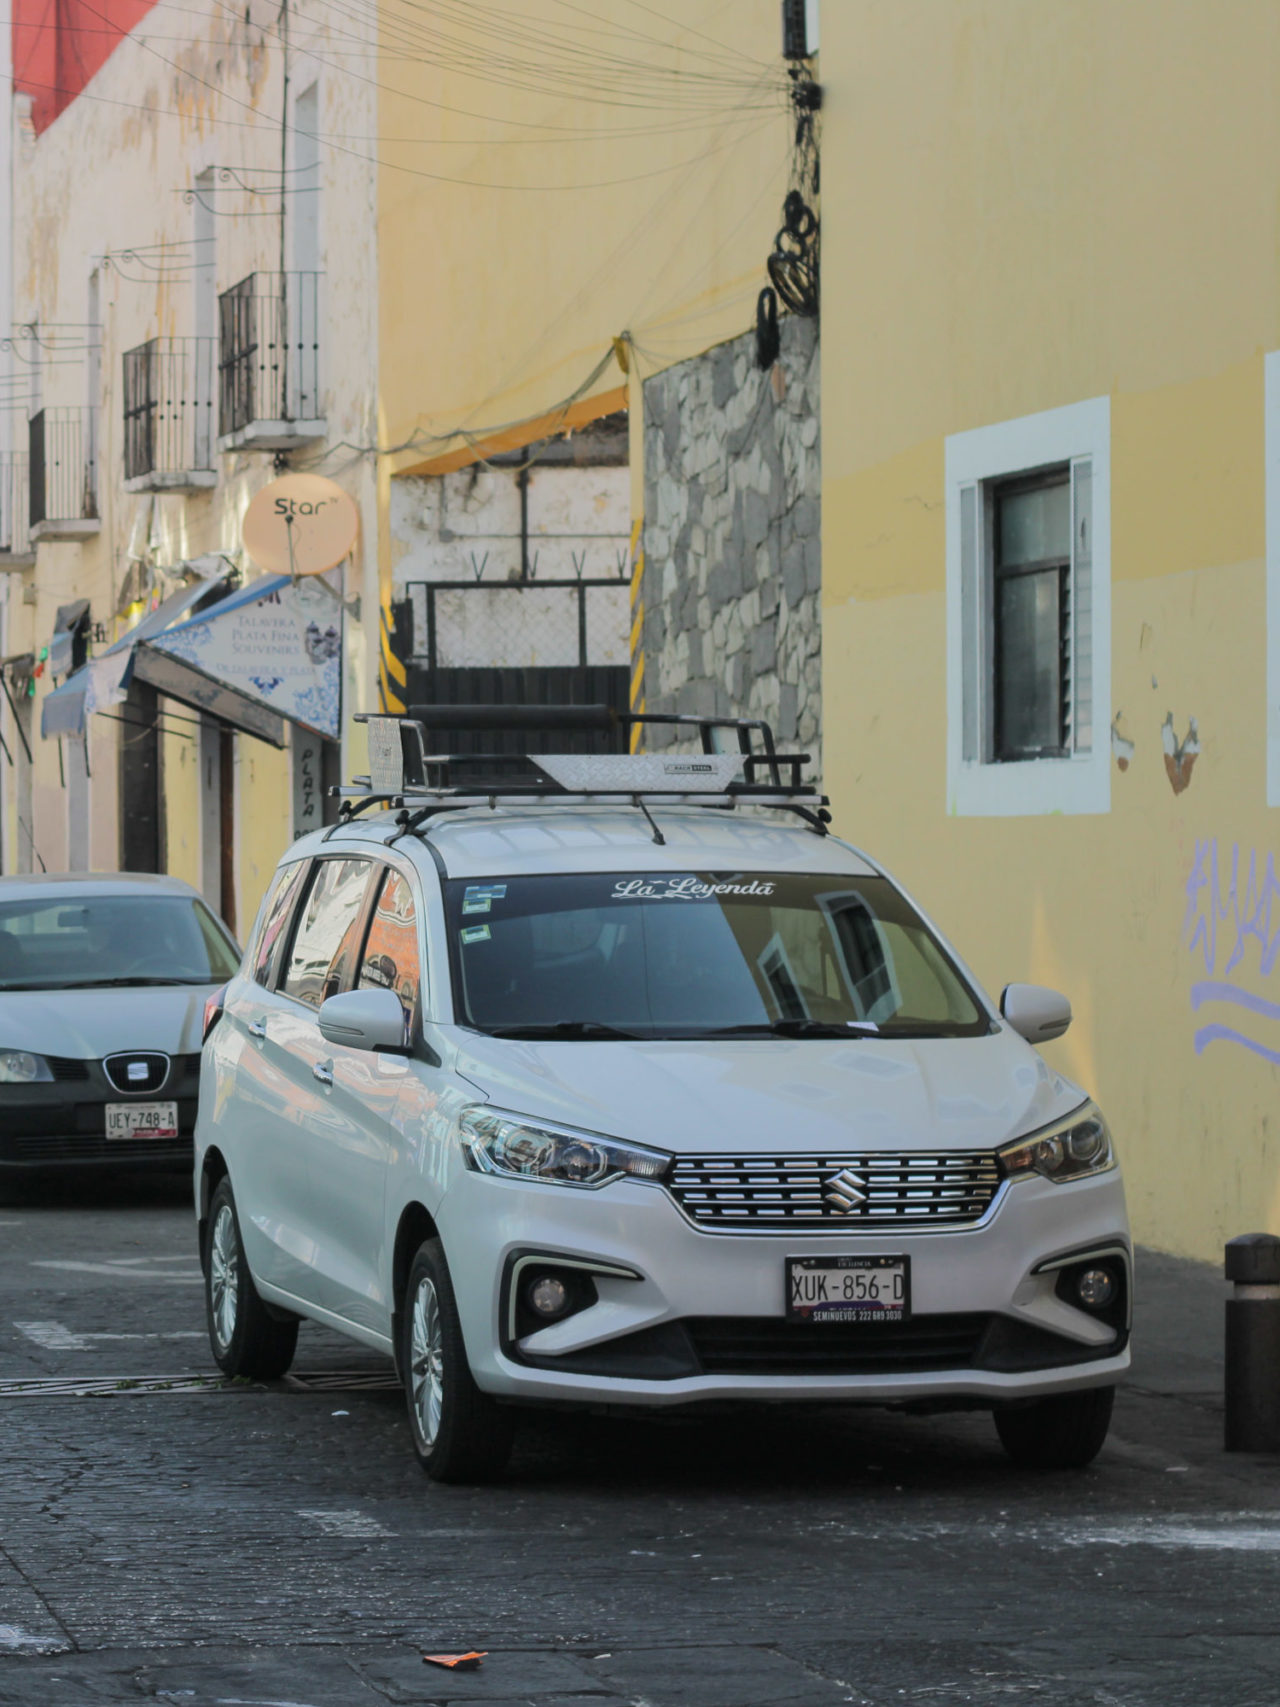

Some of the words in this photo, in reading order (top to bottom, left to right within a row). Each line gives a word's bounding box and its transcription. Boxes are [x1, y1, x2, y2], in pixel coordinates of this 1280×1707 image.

[274, 497, 328, 515] Star
[238, 616, 296, 628] TALAVERA
[232, 629, 268, 641] PLATA
[271, 630, 300, 642] FINA
[232, 642, 300, 655] SOUVENIRS
[301, 748, 315, 817] PLATA
[612, 879, 664, 899] La
[668, 877, 775, 899] Leyenda
[108, 1111, 176, 1129] UEY-748-A
[792, 1273, 905, 1302] XUK-856-D
[813, 1310, 857, 1321] SEMINUEVOS
[859, 1310, 871, 1320] 222
